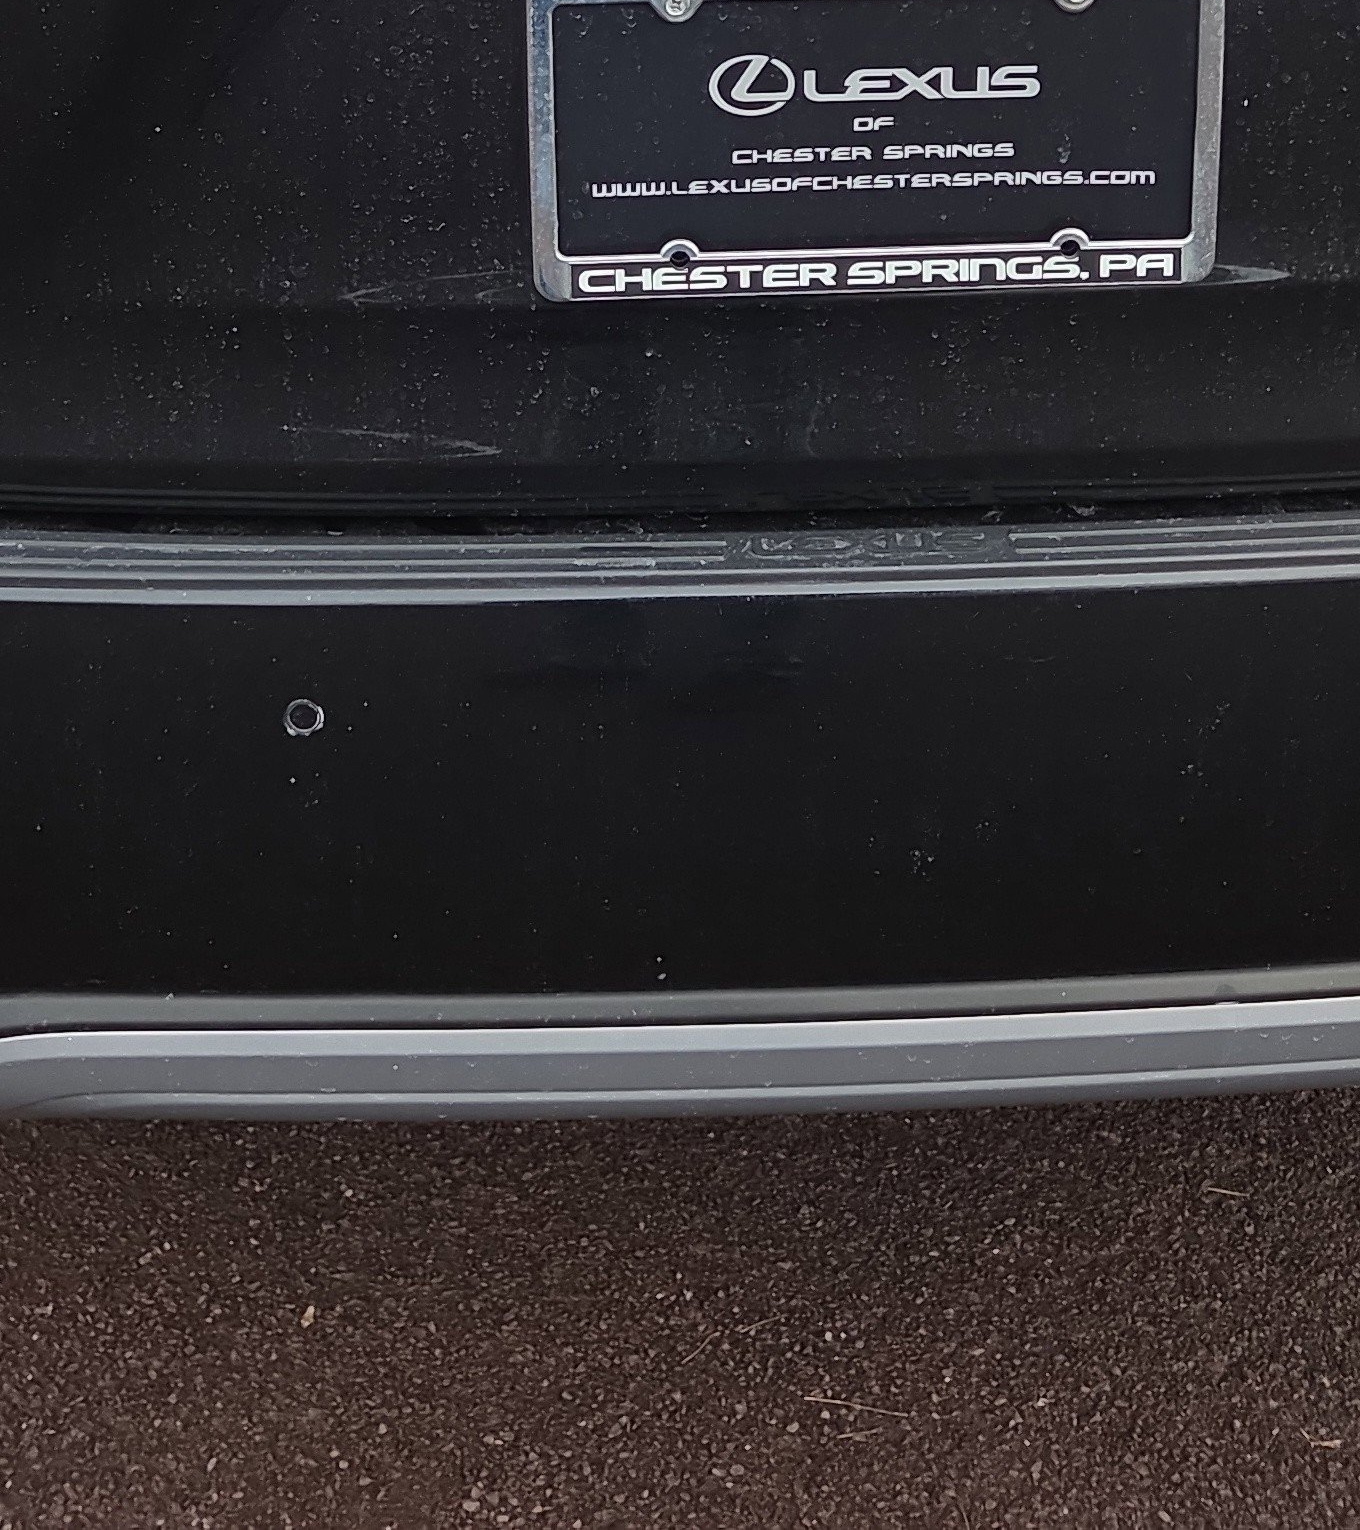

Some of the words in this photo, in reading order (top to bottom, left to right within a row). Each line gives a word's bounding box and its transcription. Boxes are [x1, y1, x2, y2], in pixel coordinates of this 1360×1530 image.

[804, 64, 1041, 102] LEXUS
[853, 116, 895, 132] OF
[731, 146, 873, 165] CHESTER
[882, 142, 1015, 160] SPRINGS
[578, 262, 837, 293] CHESTER
[846, 256, 1090, 286] SPRINGS,
[1099, 253, 1174, 278] PA
